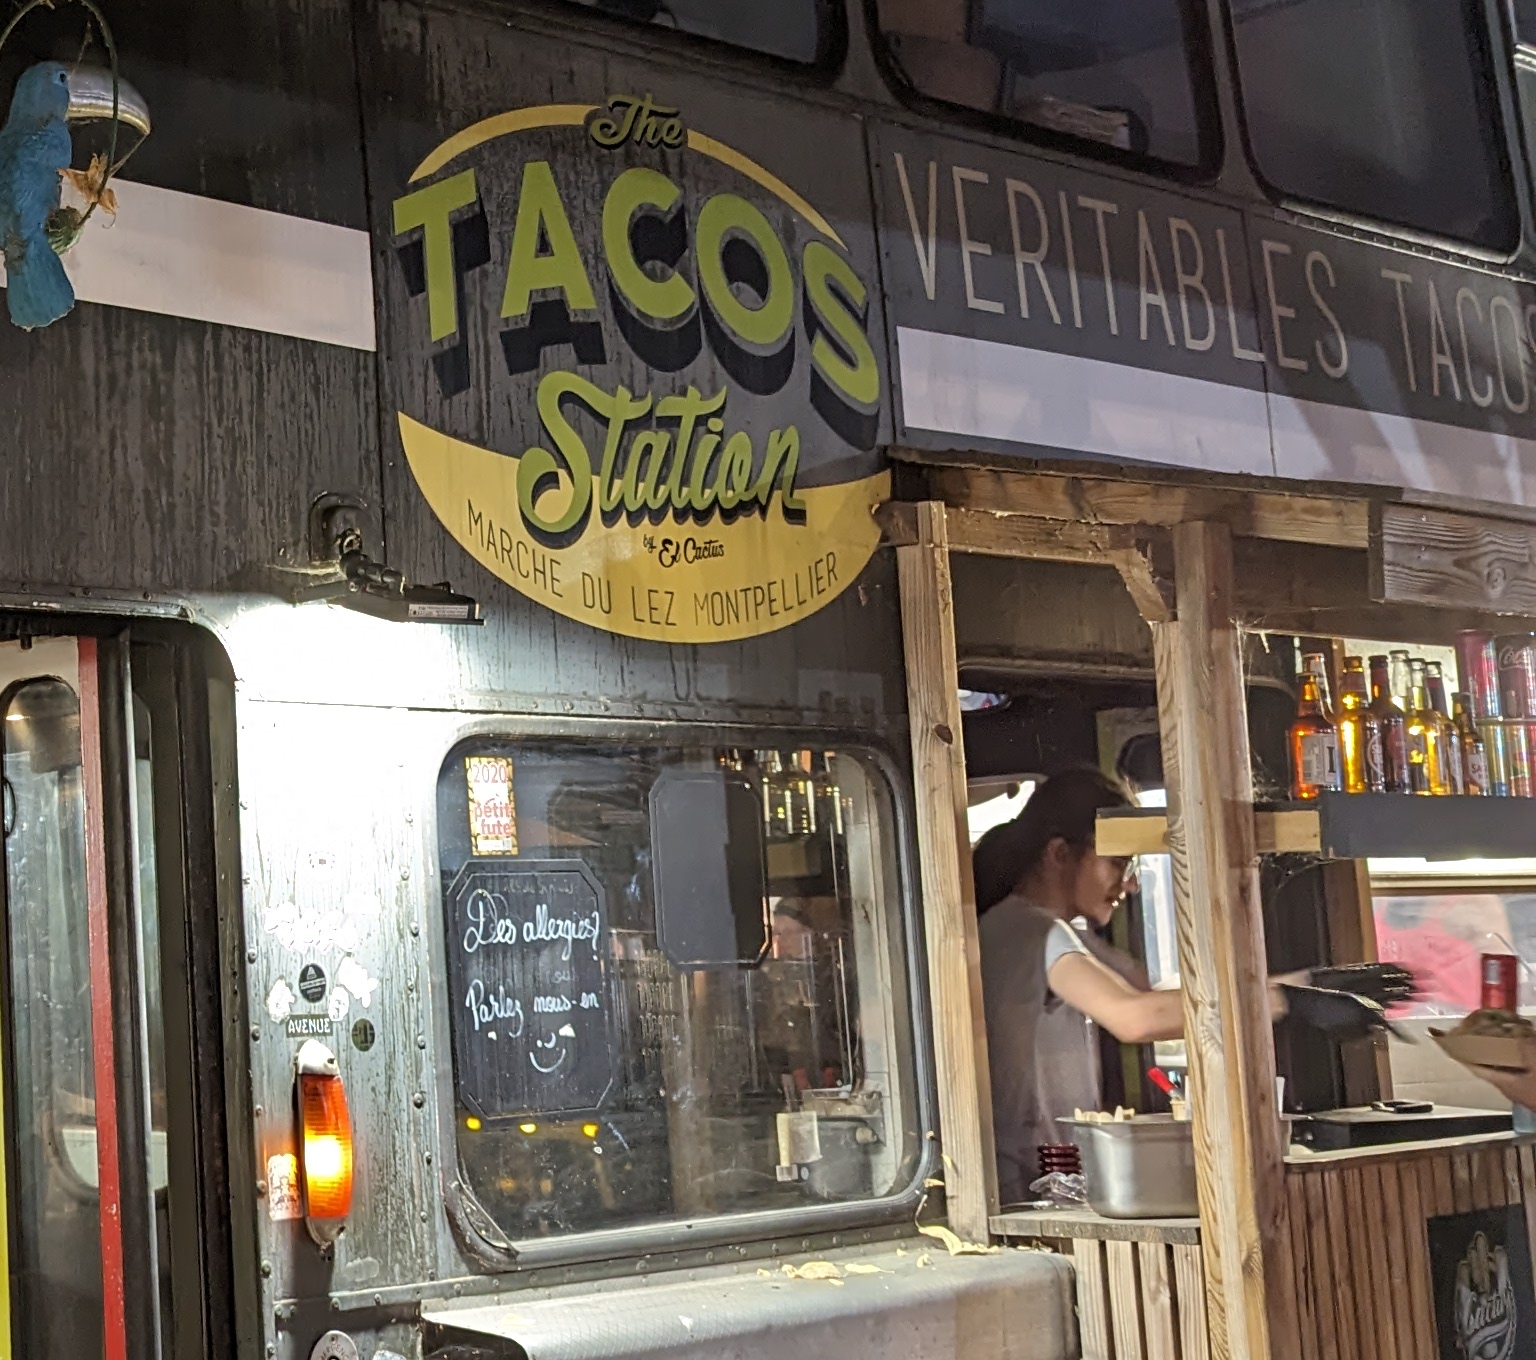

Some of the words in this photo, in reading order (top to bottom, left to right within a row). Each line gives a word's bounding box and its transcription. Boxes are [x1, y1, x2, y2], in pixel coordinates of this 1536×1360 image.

[590, 95, 689, 149] The
[392, 160, 880, 410] TACOS
[895, 152, 1348, 380] VERITABLES
[516, 371, 808, 540] Station
[466, 499, 564, 599] MARCHE
[582, 572, 613, 616] DU
[632, 584, 678, 627] LEZ
[695, 551, 839, 628] MONTPELLIER
[658, 537, 681, 568] El
[683, 537, 725, 564] Cactus
[472, 764, 509, 783] 2020
[474, 800, 514, 823] petit
[464, 888, 517, 954] Des
[287, 1018, 331, 1034] AVENUE
[465, 979, 525, 1038] Parlez
